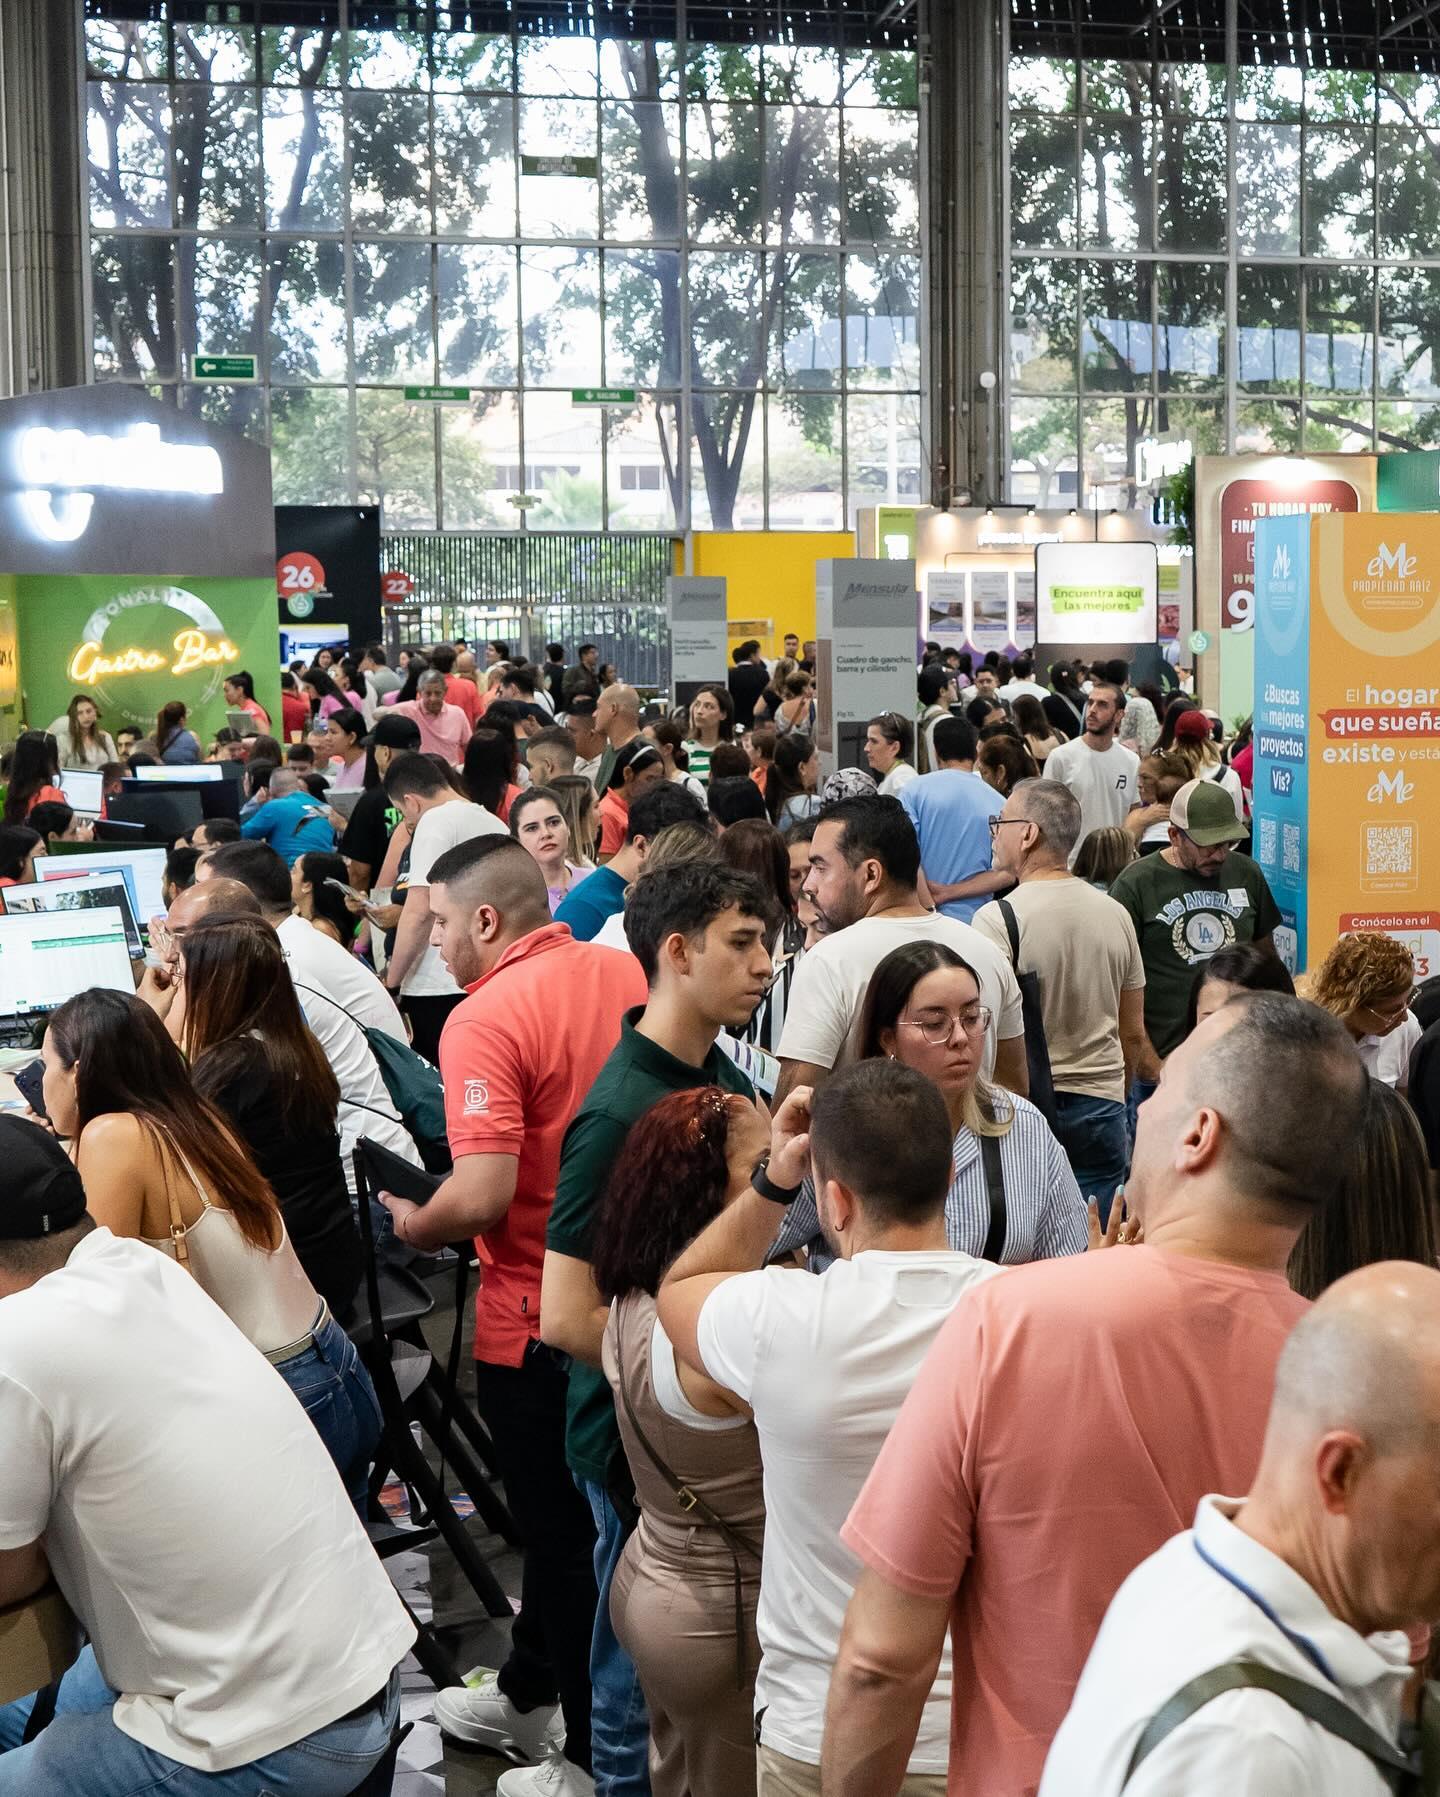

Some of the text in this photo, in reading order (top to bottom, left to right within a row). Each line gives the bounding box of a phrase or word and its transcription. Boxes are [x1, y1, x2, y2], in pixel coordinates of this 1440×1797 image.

[1251, 503, 1266, 516] TU
[1367, 542, 1417, 578] eMe
[282, 565, 315, 588] 26
[386, 580, 407, 594] 22
[1353, 580, 1406, 593] PROPIEDAD
[1053, 589, 1142, 600] Encuentra aquí
[1064, 600, 1131, 612] las mejores
[70, 630, 239, 684] Gastro Bar
[836, 655, 867, 664] Cuadro
[869, 655, 879, 663] de
[836, 665, 859, 673] barra
[866, 665, 898, 673] cilindro
[1264, 684, 1300, 705] ¿Buscas
[1346, 684, 1440, 708] El hogar
[1269, 707, 1305, 730] mejores
[1330, 716, 1374, 735] que
[1260, 736, 1304, 758] proyectos
[1322, 743, 1395, 764] existe
[1399, 750, 1408, 761] y
[1155, 897, 1186, 926] LOS
[1351, 916, 1430, 928] Conócelo en el
[1198, 922, 1213, 943] LA
